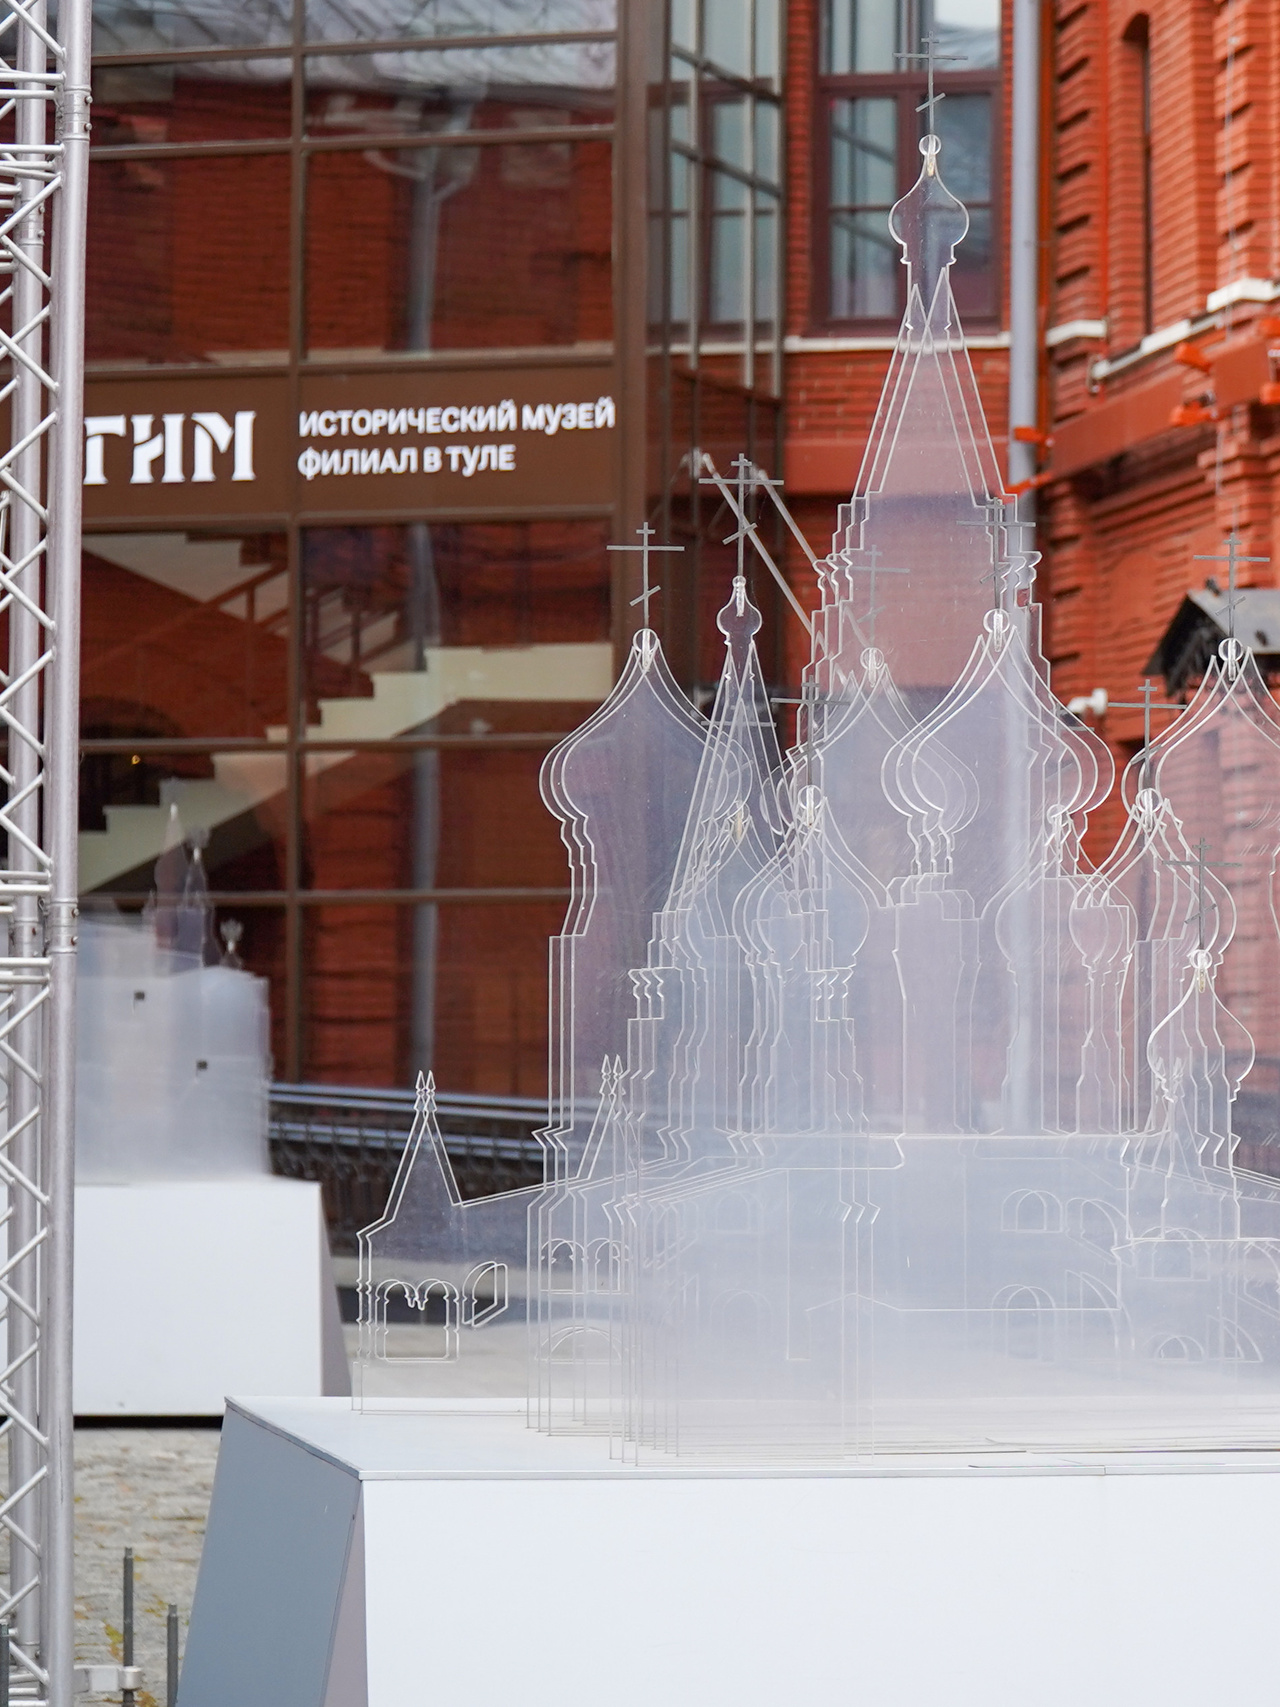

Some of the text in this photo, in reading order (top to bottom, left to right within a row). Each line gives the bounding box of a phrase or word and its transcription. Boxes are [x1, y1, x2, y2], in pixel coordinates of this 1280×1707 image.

[299, 396, 616, 437] ИСТОРИЧЕСКИЙ МУЗЕЙ
[83, 410, 257, 485] ГИМ
[297, 444, 517, 481] ФИЛИАЛ В ТУЛЕ
